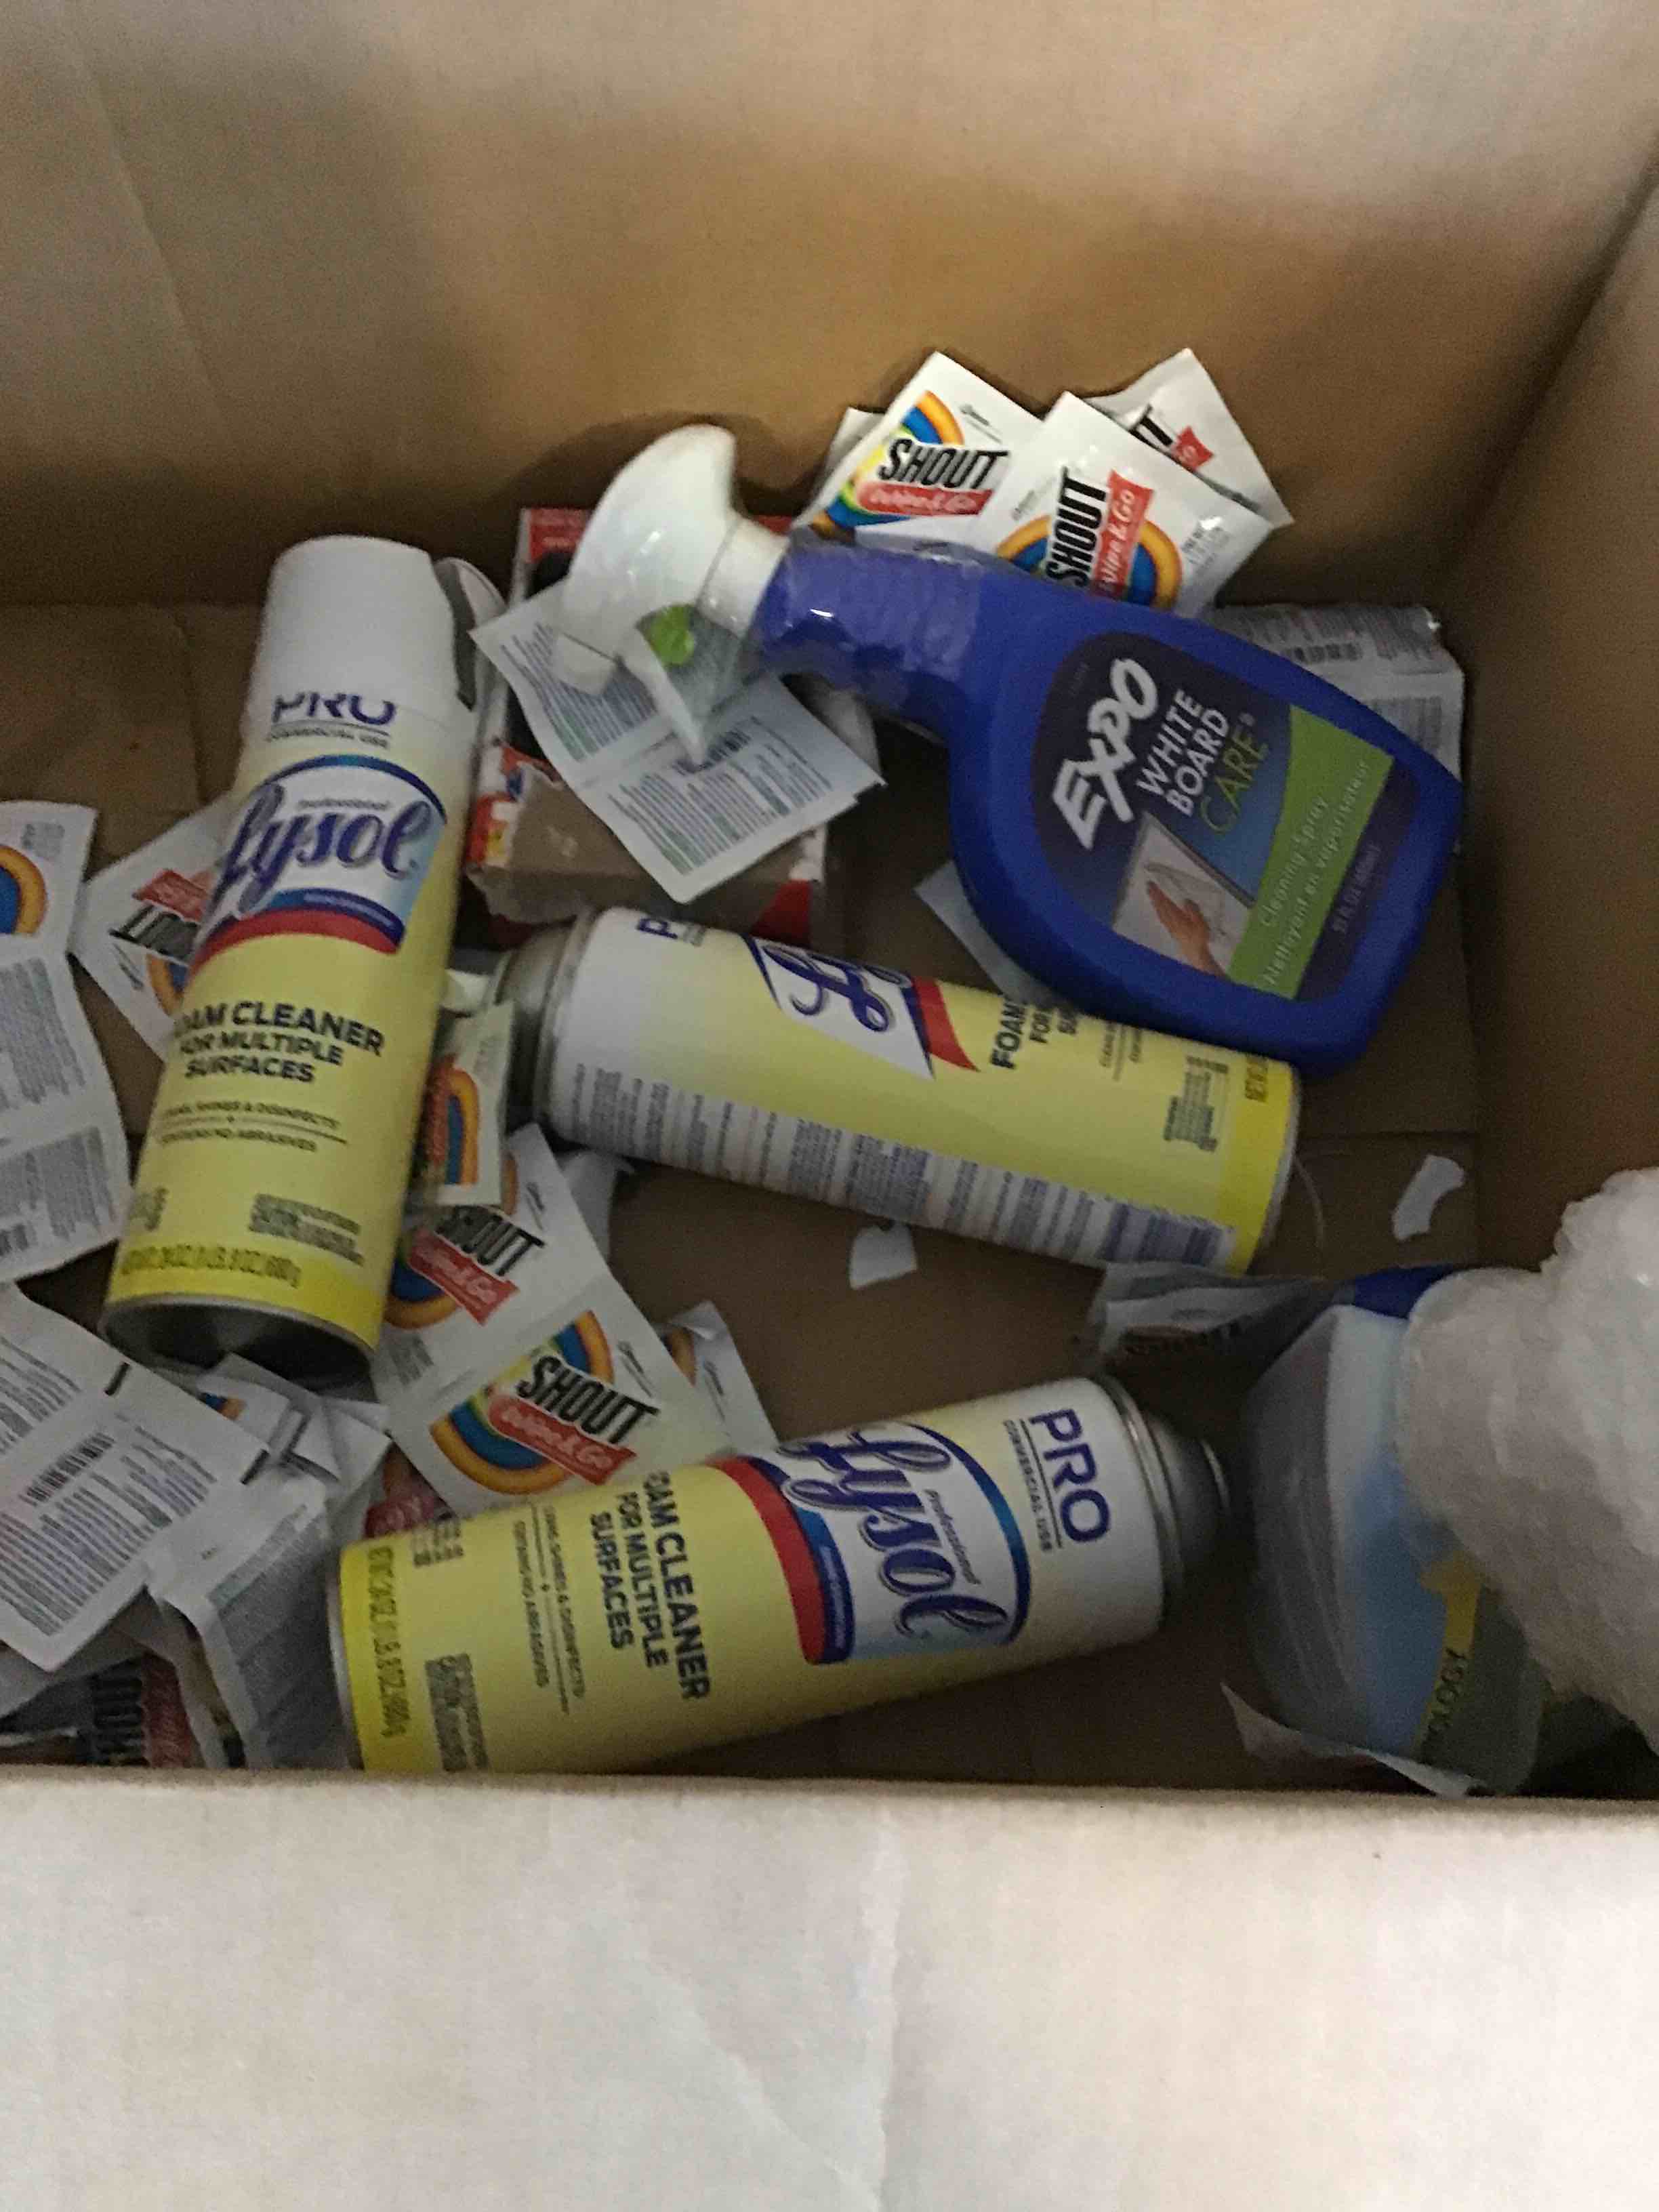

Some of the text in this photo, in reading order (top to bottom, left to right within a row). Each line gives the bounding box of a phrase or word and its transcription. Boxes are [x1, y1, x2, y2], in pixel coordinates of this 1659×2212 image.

[878, 438, 1008, 489] SHOUT
[1046, 466, 1107, 588] SHOUT
[1052, 658, 1158, 851] EXPO
[1136, 689, 1202, 798] WHITE
[1166, 709, 1230, 817] BOARD
[209, 781, 432, 913] Lysol
[1261, 851, 1306, 928] Cleaning
[173, 1001, 386, 1057] OAM CLEANER
[185, 1055, 316, 1083] SURFACES
[221, 1031, 344, 1067] MULTIPLE
[516, 1355, 661, 1445] SHOUT
[777, 1431, 1008, 1635] Lysol
[1028, 1408, 1111, 1543] PRO
[590, 1511, 635, 1650] SURFACES
[617, 1491, 669, 1668] FOR MULTIPLE
[643, 1471, 711, 1700] OAM CLEANER
